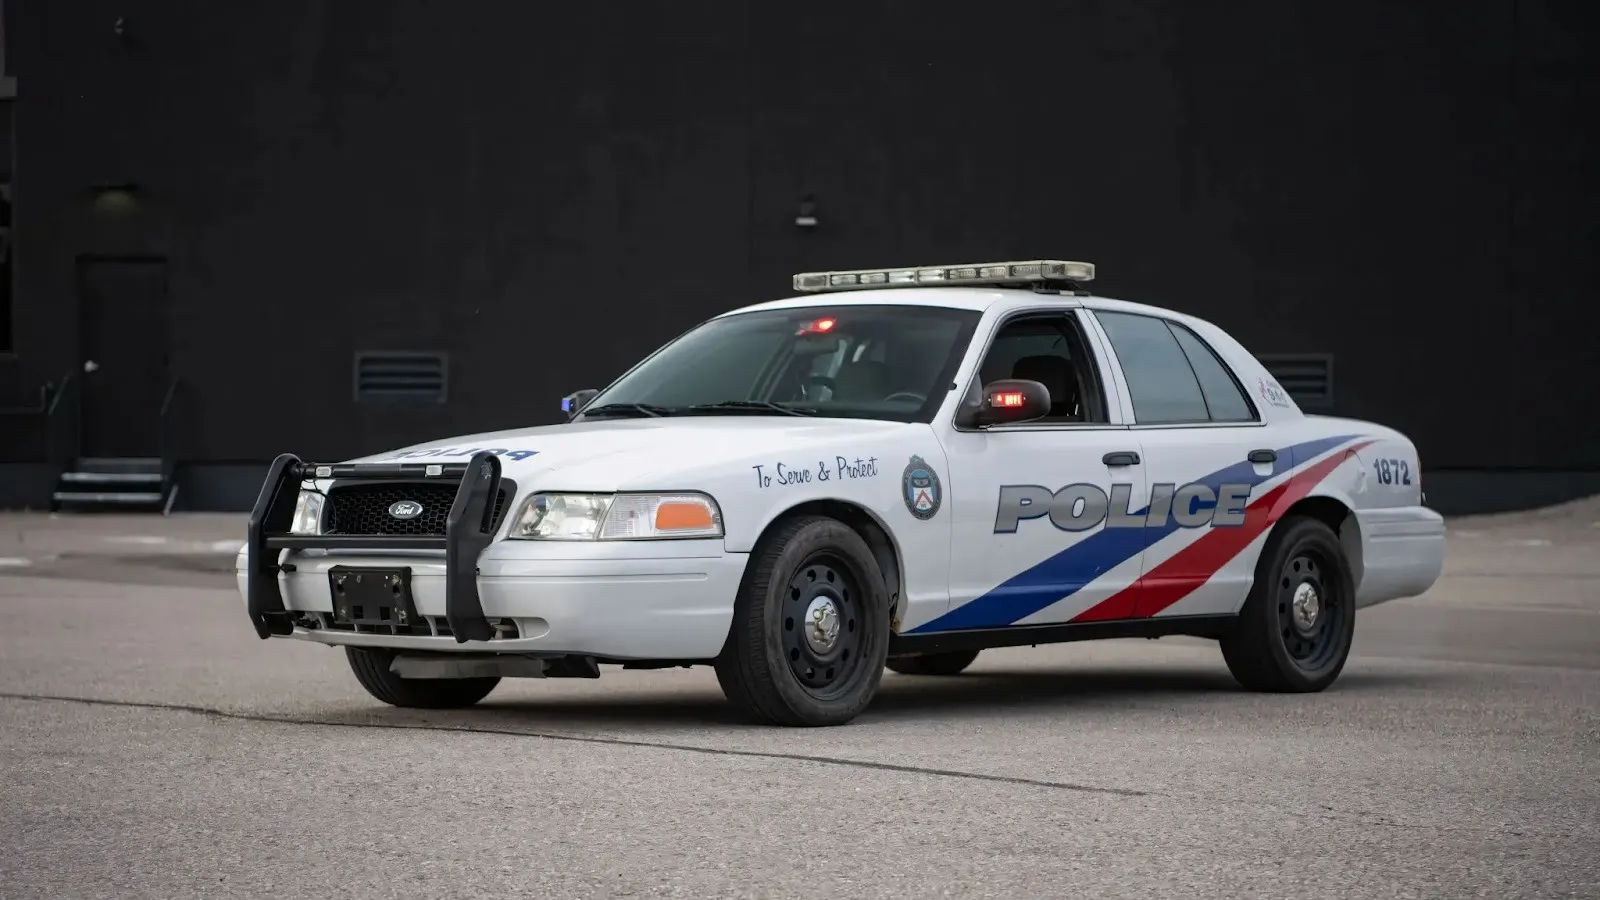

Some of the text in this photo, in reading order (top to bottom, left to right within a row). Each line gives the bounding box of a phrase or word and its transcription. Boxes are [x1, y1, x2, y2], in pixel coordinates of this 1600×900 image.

[752, 456, 878, 488] To Serve & Protect
[1373, 458, 1411, 486] 1872
[395, 504, 414, 516] Ford
[993, 482, 1252, 534] POLICE
